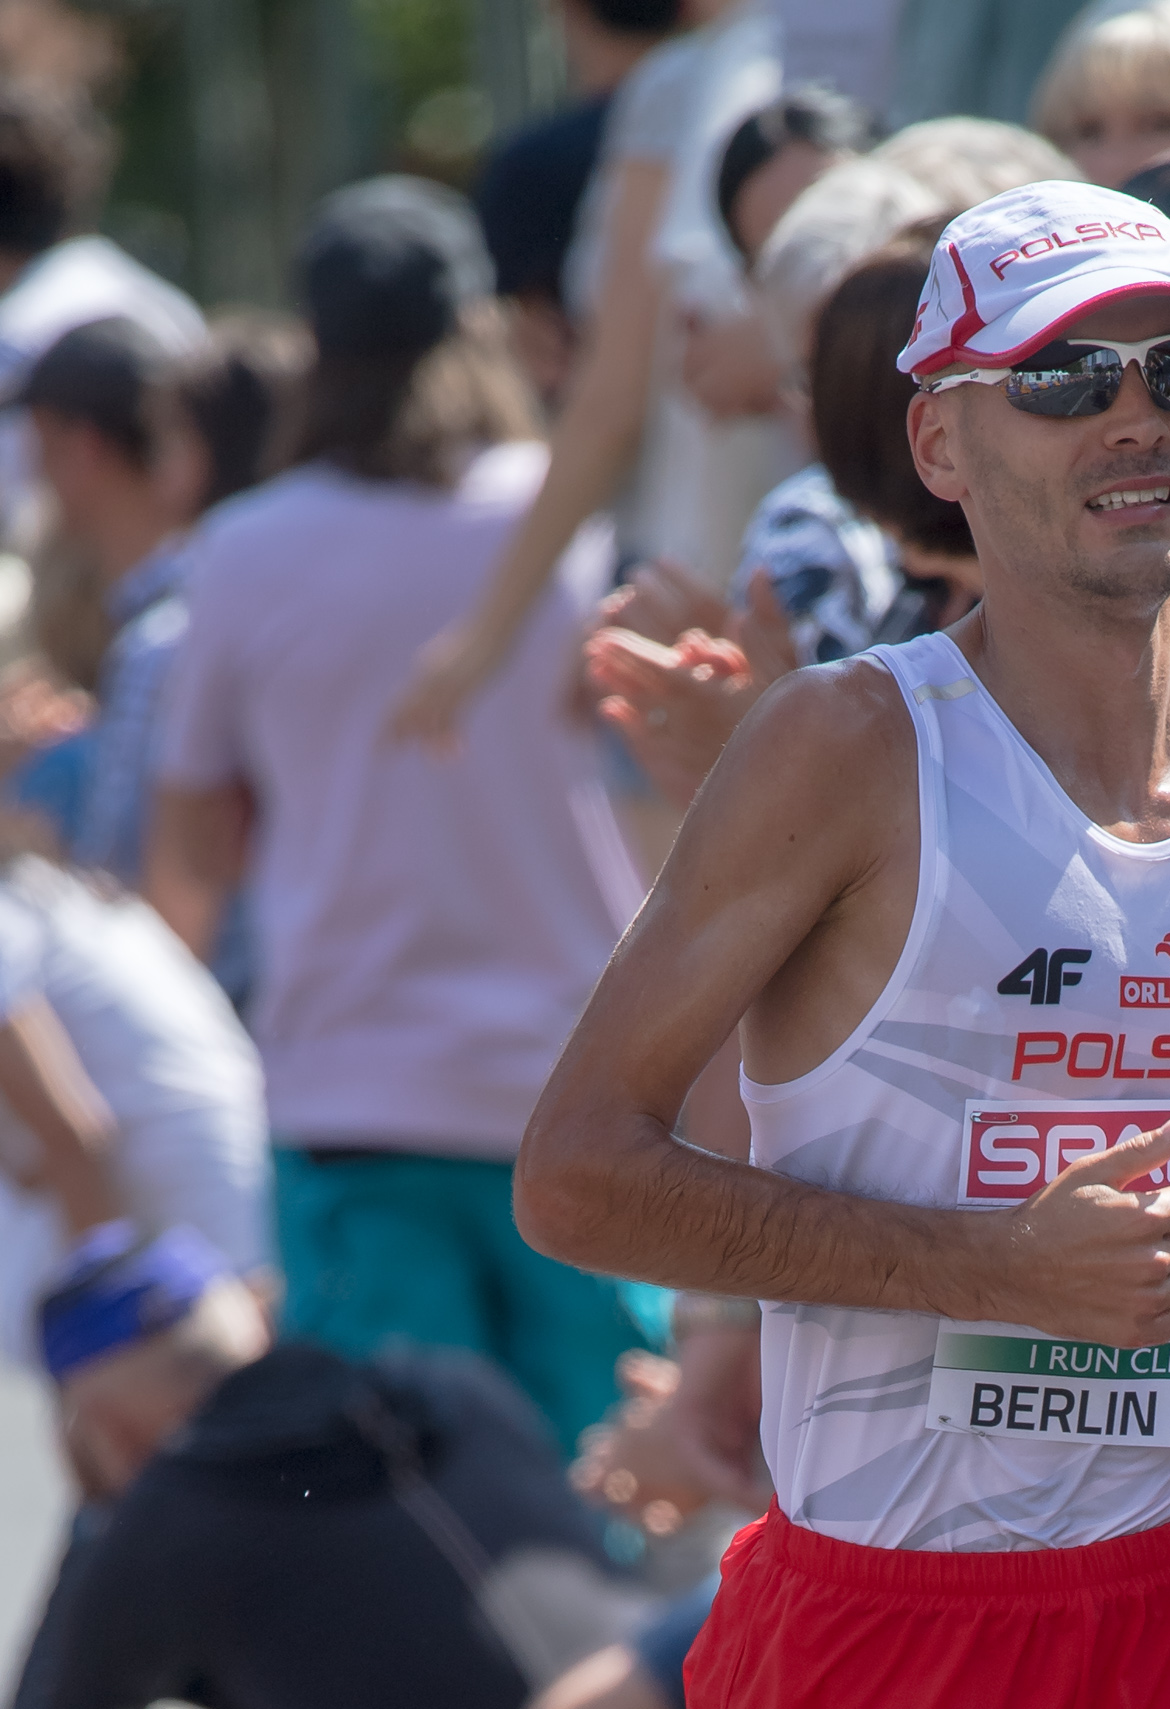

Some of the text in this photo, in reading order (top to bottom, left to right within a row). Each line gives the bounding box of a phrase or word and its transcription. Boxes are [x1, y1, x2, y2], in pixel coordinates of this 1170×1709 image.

[989, 221, 1166, 281] POLSKA
[997, 948, 1092, 1005] 4F
[1029, 1344, 1037, 1369] I
[1049, 1345, 1119, 1374] RUN
[970, 1382, 1157, 1437] BERLIN
